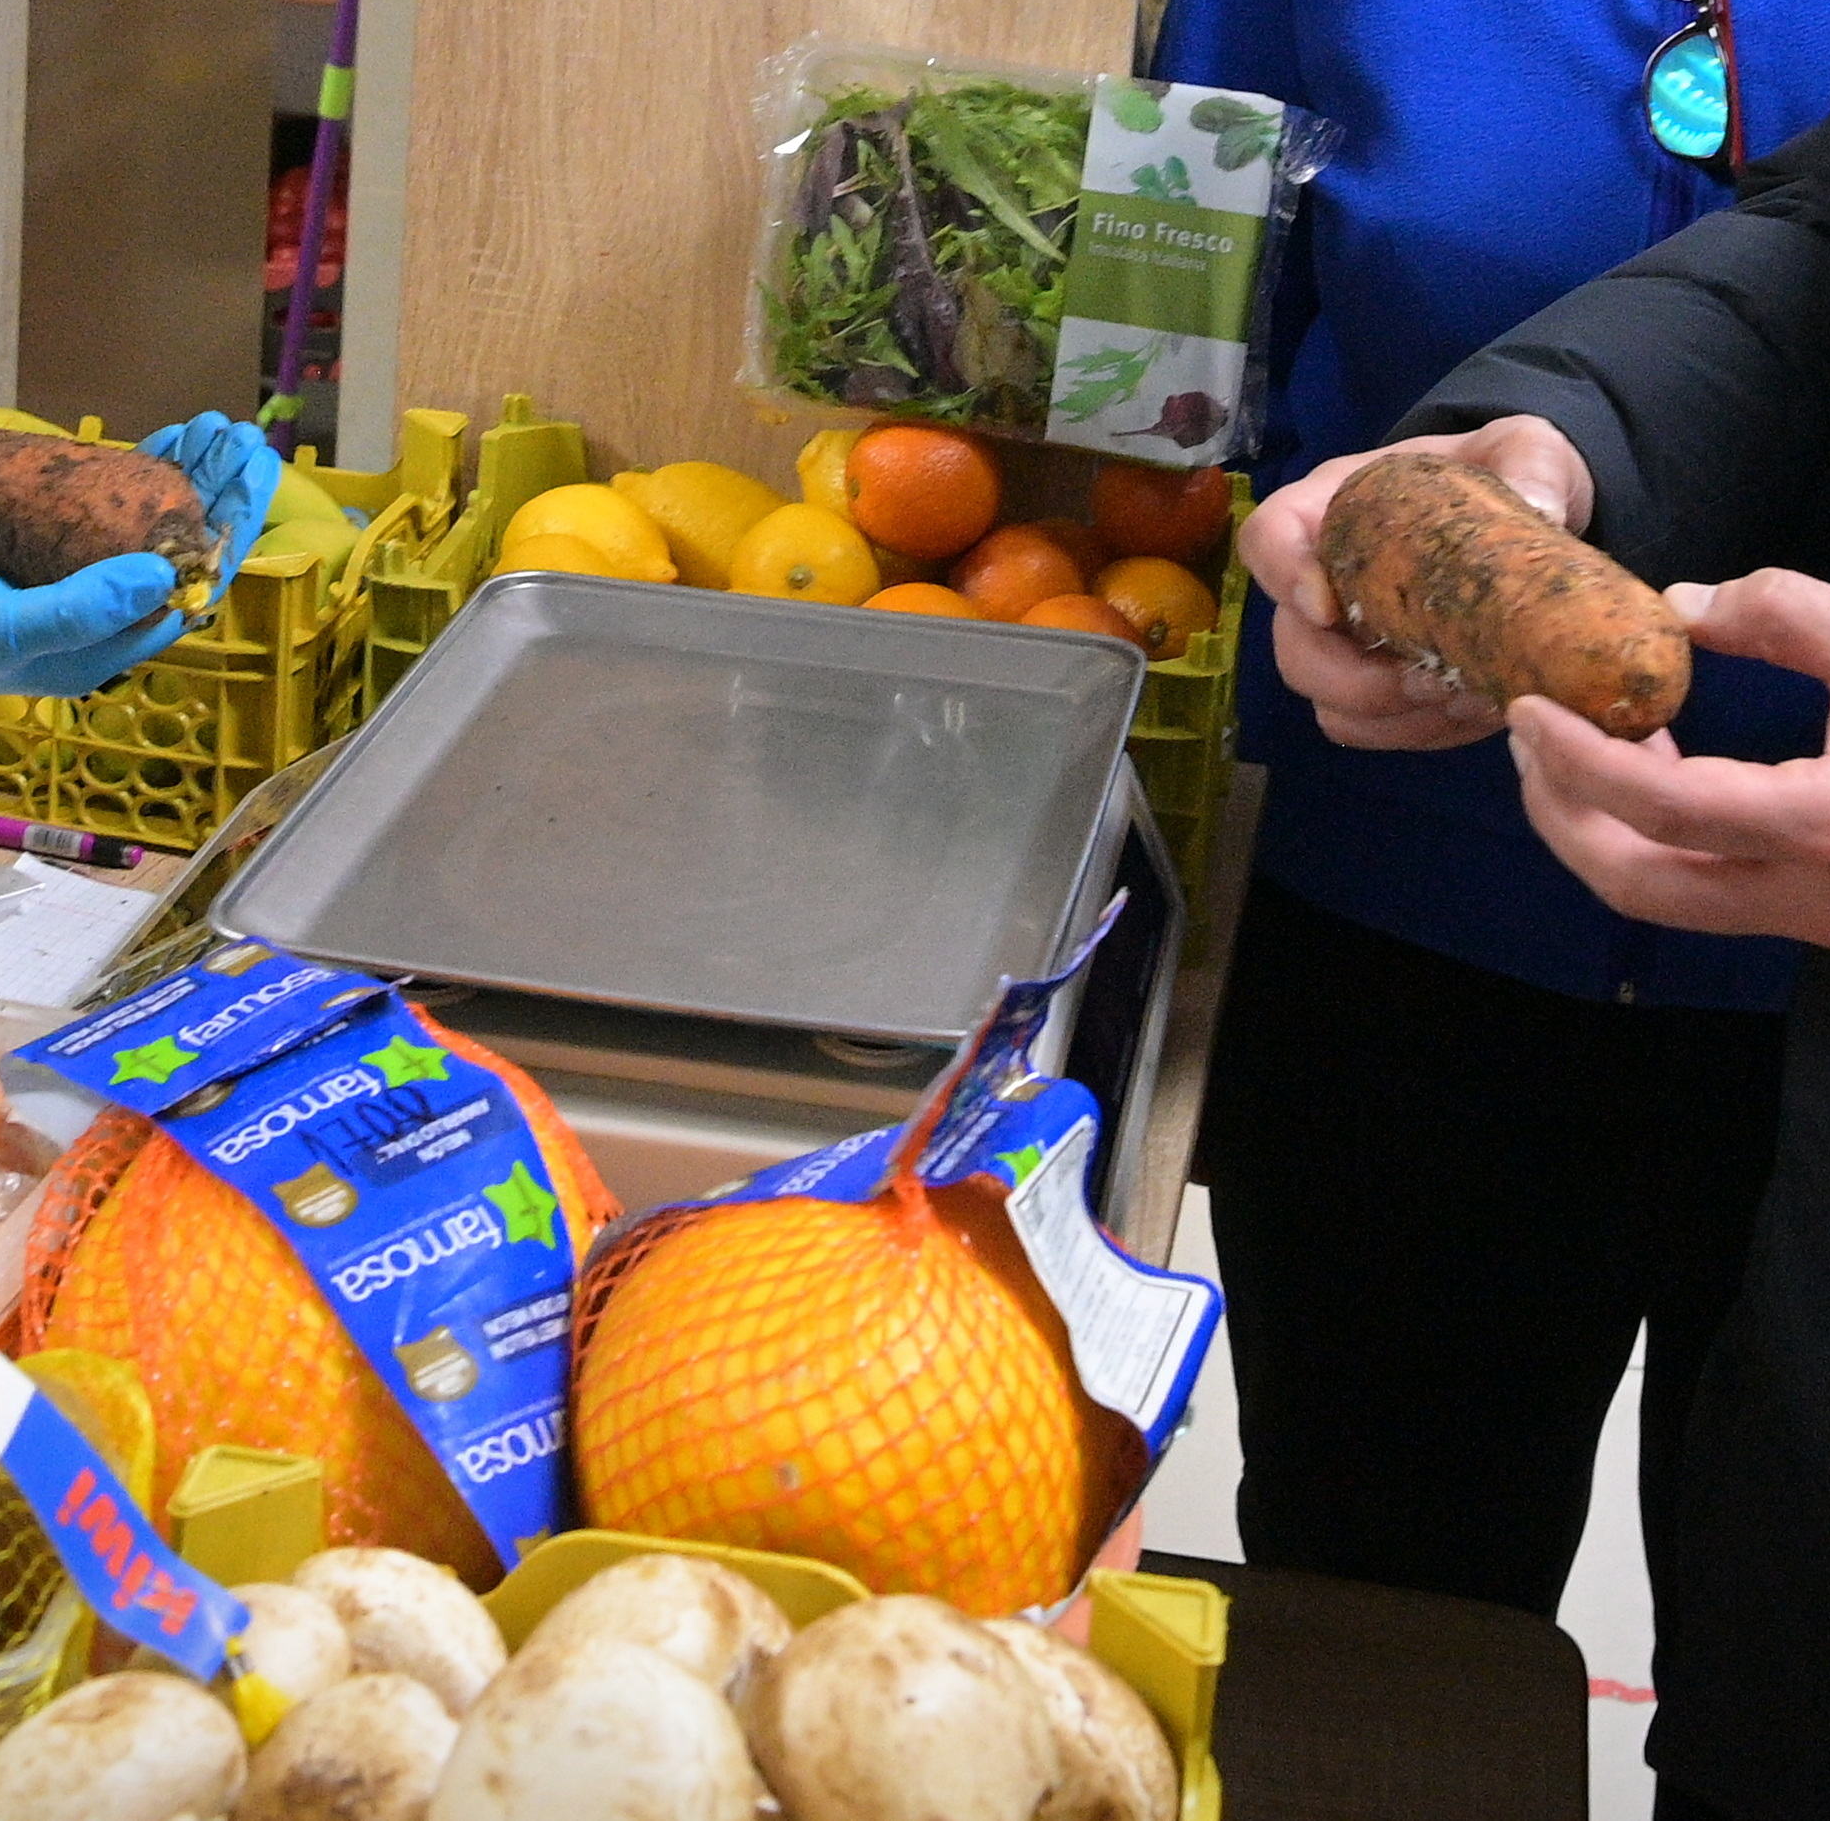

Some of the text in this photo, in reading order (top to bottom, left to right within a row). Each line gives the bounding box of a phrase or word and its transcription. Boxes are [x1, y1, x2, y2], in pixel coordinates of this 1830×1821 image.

[1092, 211, 1237, 254] Fino Fresco
[209, 1068, 383, 1165] famosa
[330, 1205, 503, 1303] famosa
[55, 1465, 200, 1637] kiwi
